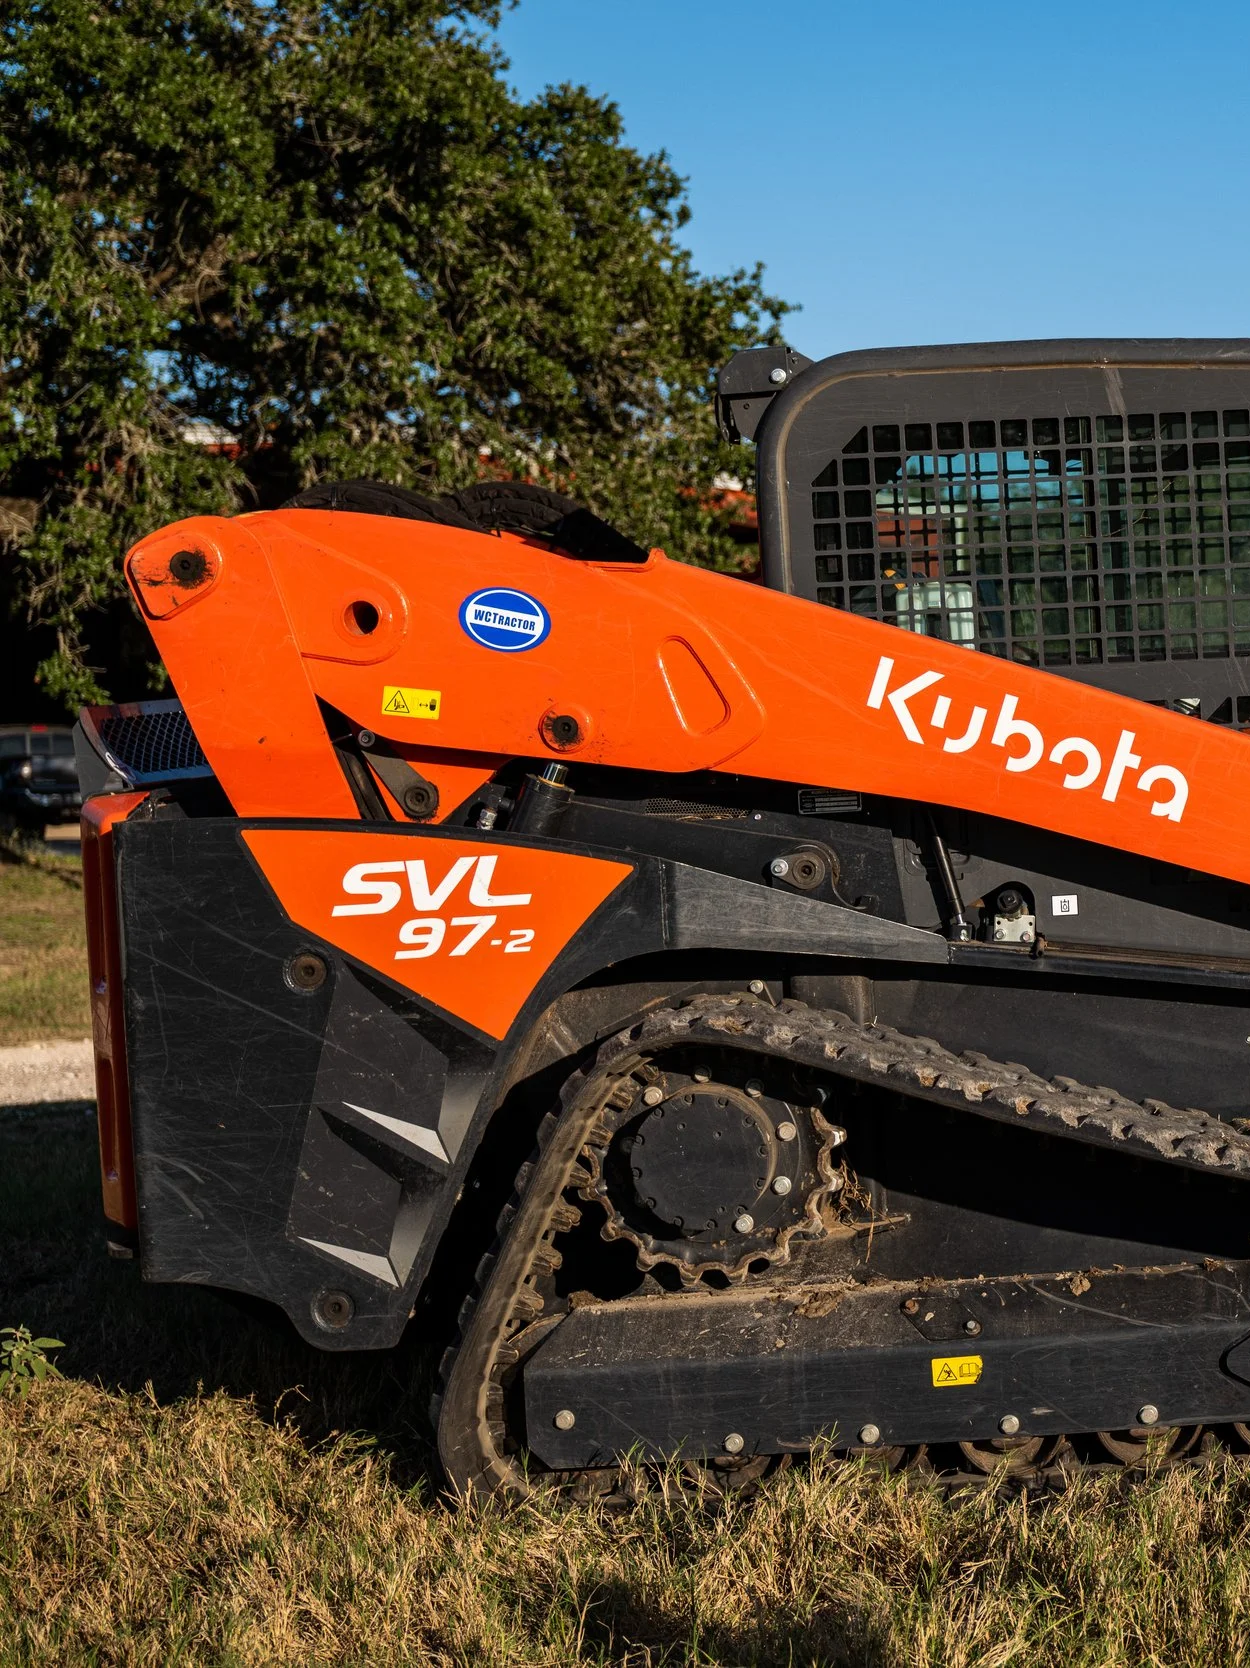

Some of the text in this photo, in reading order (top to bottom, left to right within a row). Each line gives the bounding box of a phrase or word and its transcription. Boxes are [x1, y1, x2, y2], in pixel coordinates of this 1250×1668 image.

[474, 608, 536, 632] WCTRACTOR
[866, 655, 1189, 823] Kubota
[331, 855, 532, 917] SVL
[394, 914, 535, 960] 97-2
